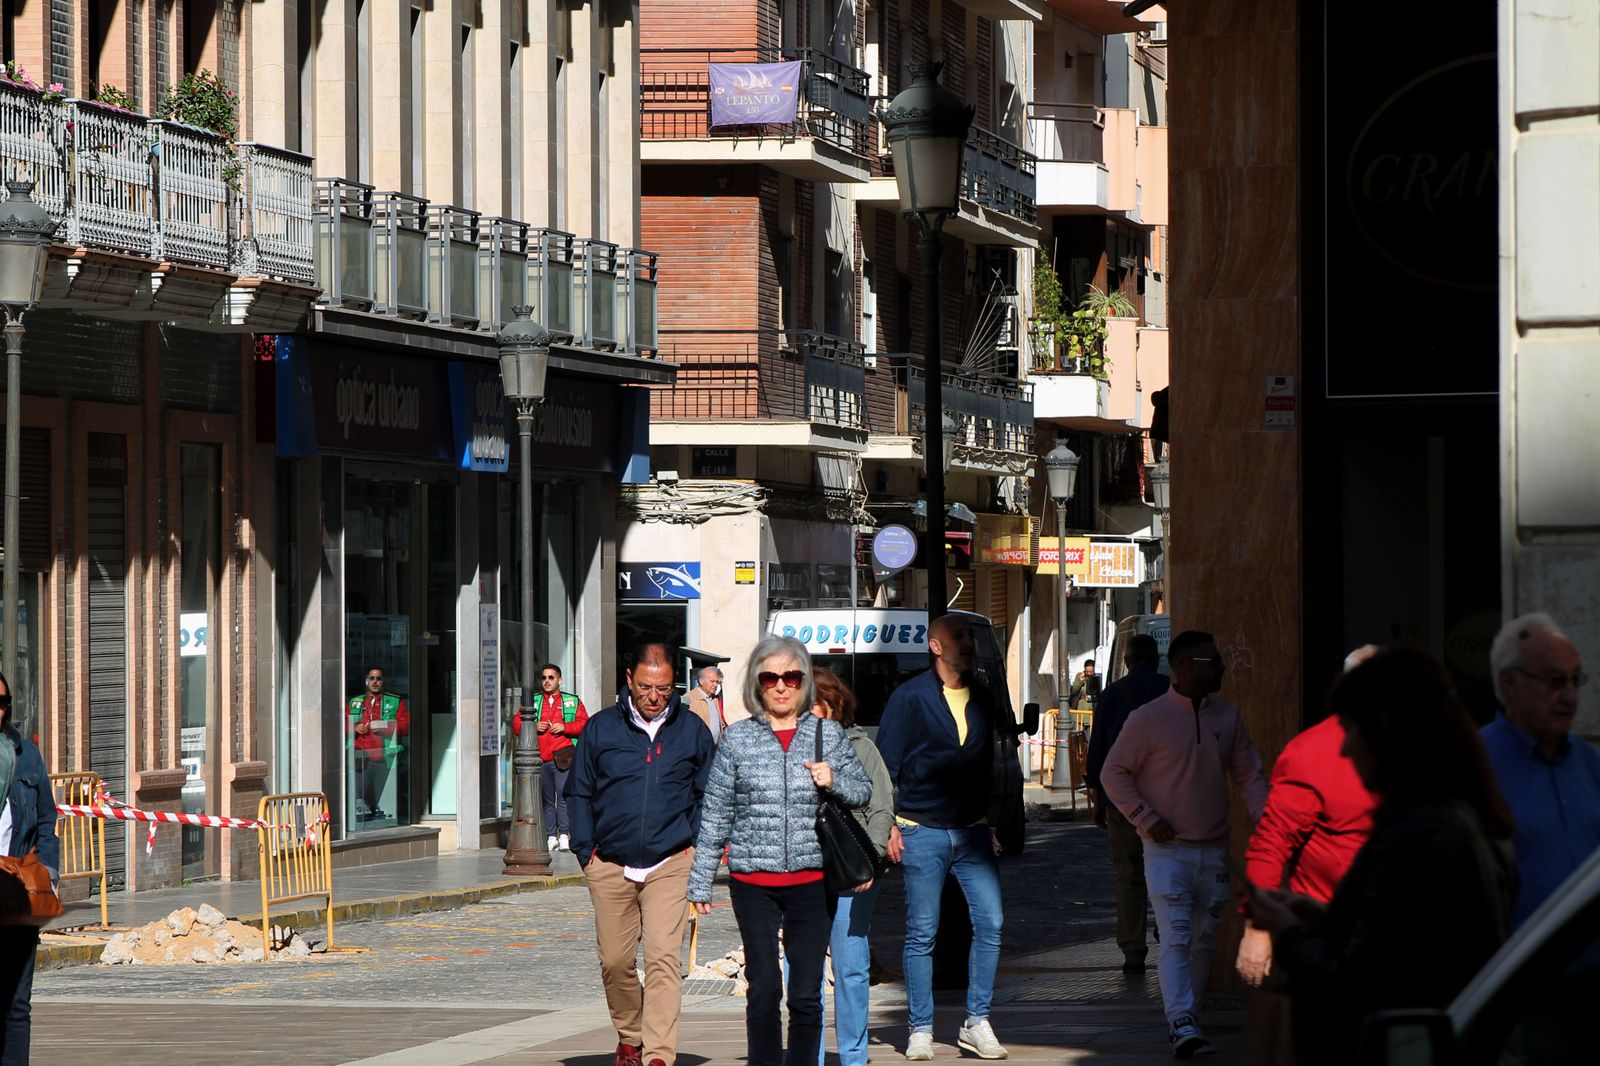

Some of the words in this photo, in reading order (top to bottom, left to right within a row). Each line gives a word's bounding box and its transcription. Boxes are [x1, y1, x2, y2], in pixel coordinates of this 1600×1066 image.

[726, 95, 780, 106] LEPANTO
[378, 368, 419, 430] urbano
[1039, 551, 1080, 561] FOTORIX
[782, 624, 927, 645] RODRIGUEZ
